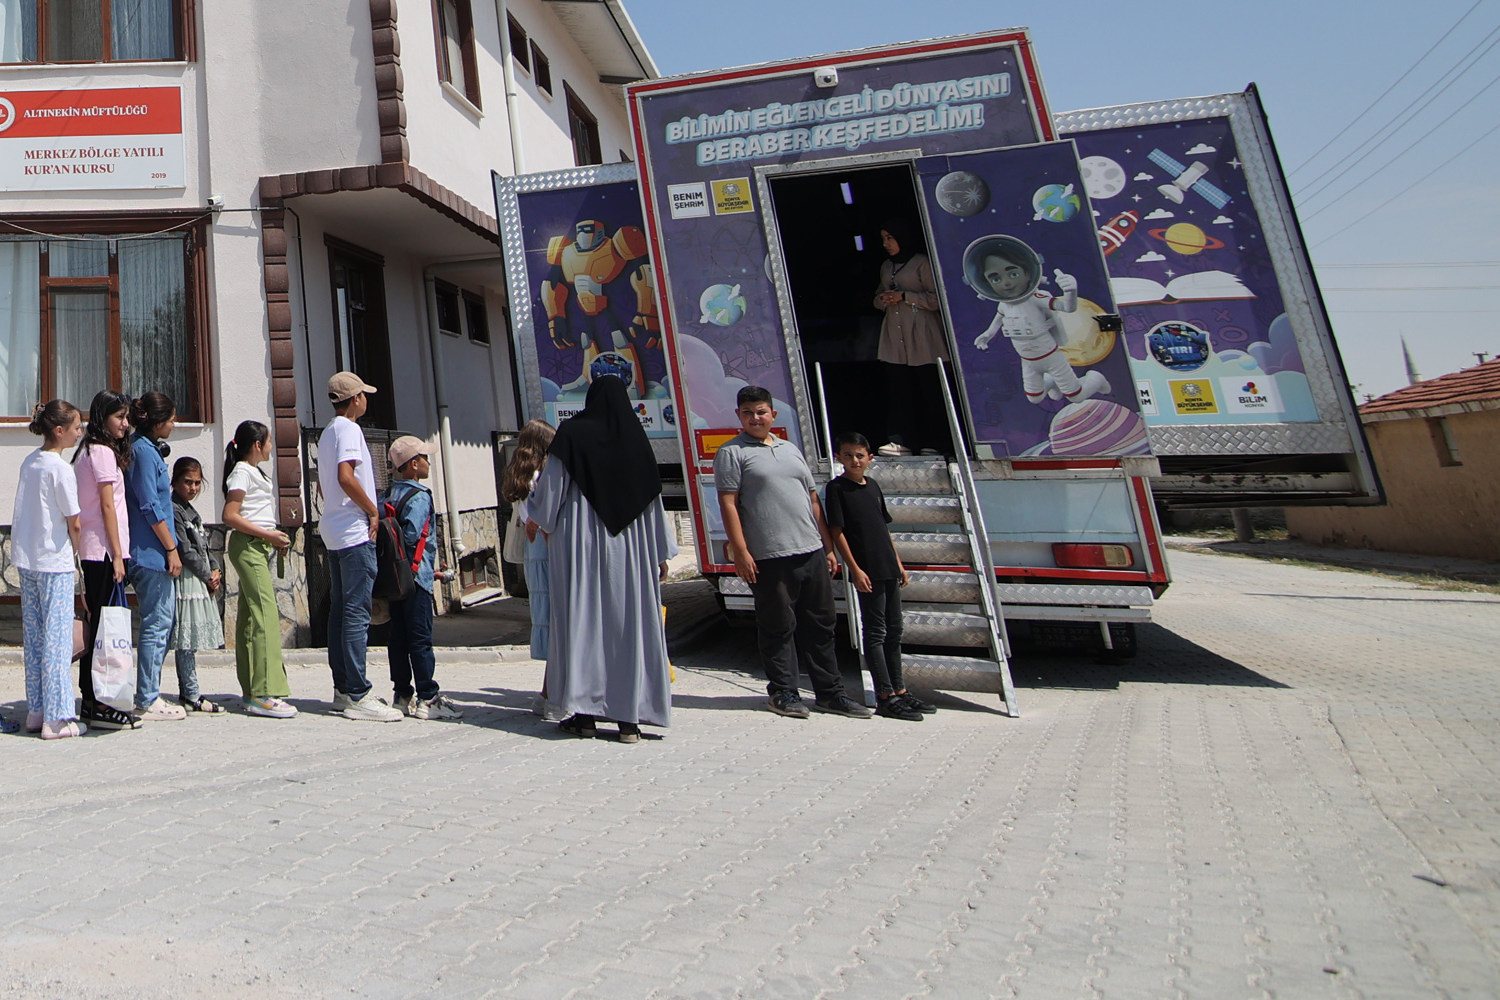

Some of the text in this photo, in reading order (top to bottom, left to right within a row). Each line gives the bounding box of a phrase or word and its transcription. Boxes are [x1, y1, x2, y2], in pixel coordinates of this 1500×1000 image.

[23, 104, 149, 118] ALTINEKİN MÜFTÜLÜĞÜ
[669, 73, 1010, 143] BİLİMİN EĞLENCELİ DÜNYASINI
[700, 104, 984, 165] BERABER KEŞFEDELİM!
[24, 146, 165, 160] MERKEZ BÖLGE YATILI
[72, 163, 115, 174] KURSU
[673, 191, 703, 202] BENİM
[674, 200, 705, 210] ŞEHRİM
[1238, 395, 1268, 404] BİLİM
